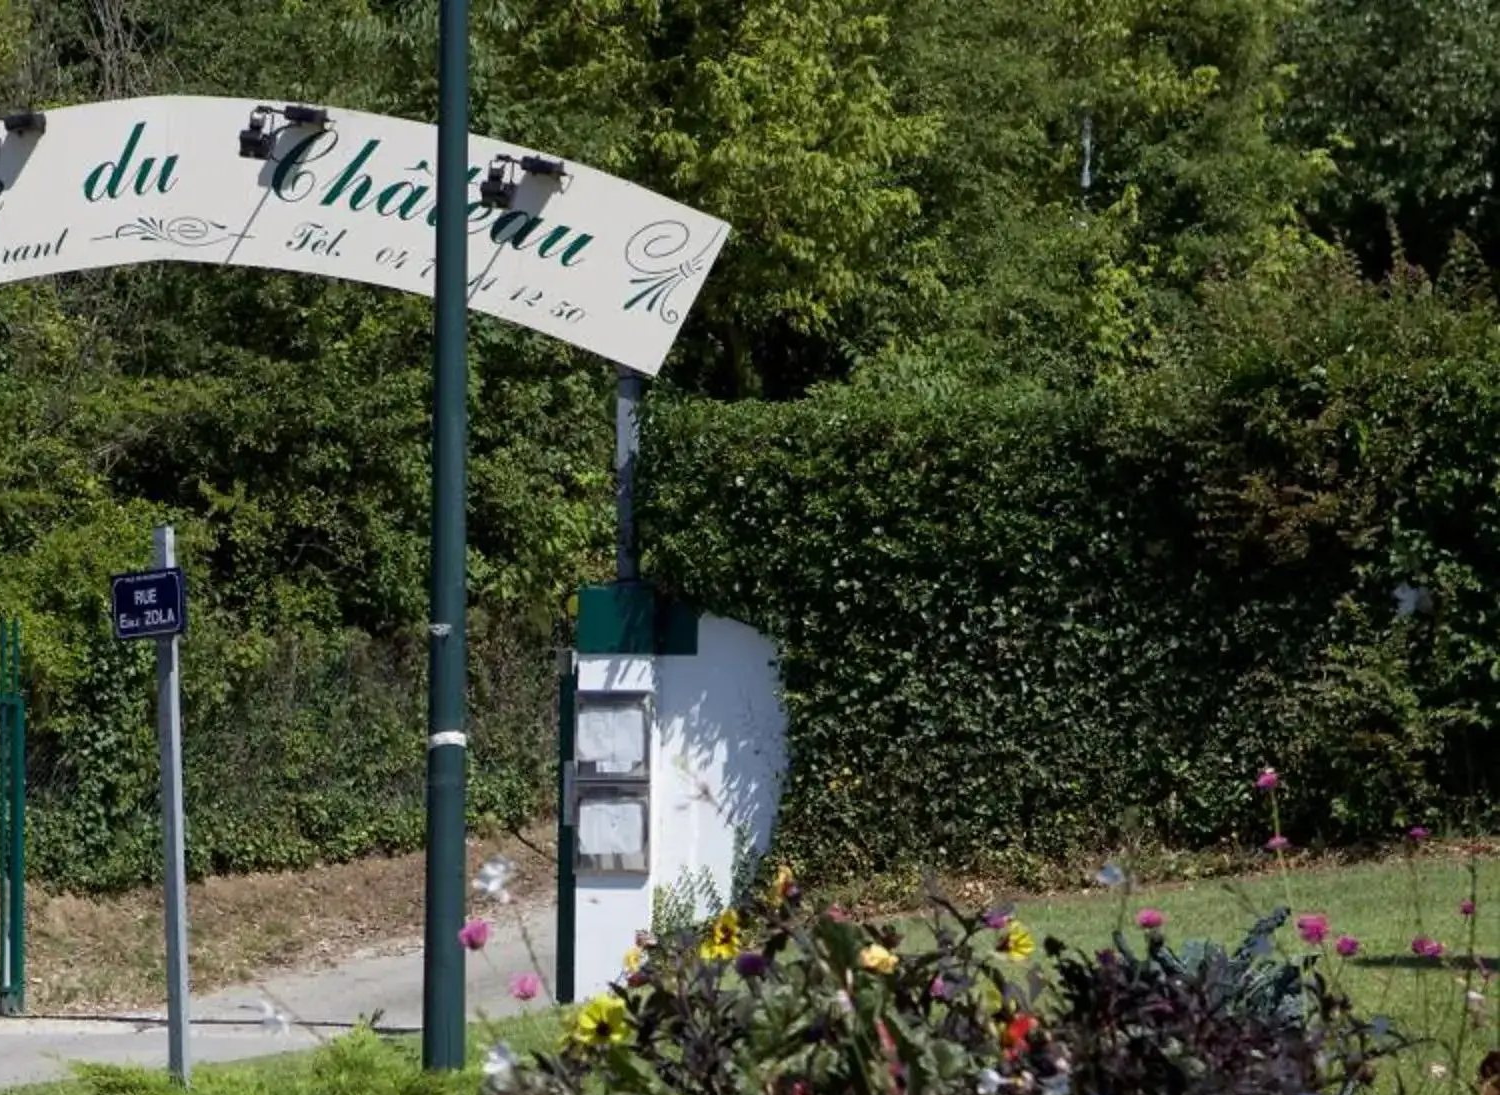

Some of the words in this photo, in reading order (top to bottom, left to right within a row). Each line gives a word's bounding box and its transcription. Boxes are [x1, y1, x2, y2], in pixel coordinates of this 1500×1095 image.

[83, 120, 181, 202] du
[286, 222, 348, 257] Tél.
[375, 246, 409, 270] 04
[509, 285, 544, 307] 12
[133, 587, 157, 606] RUE
